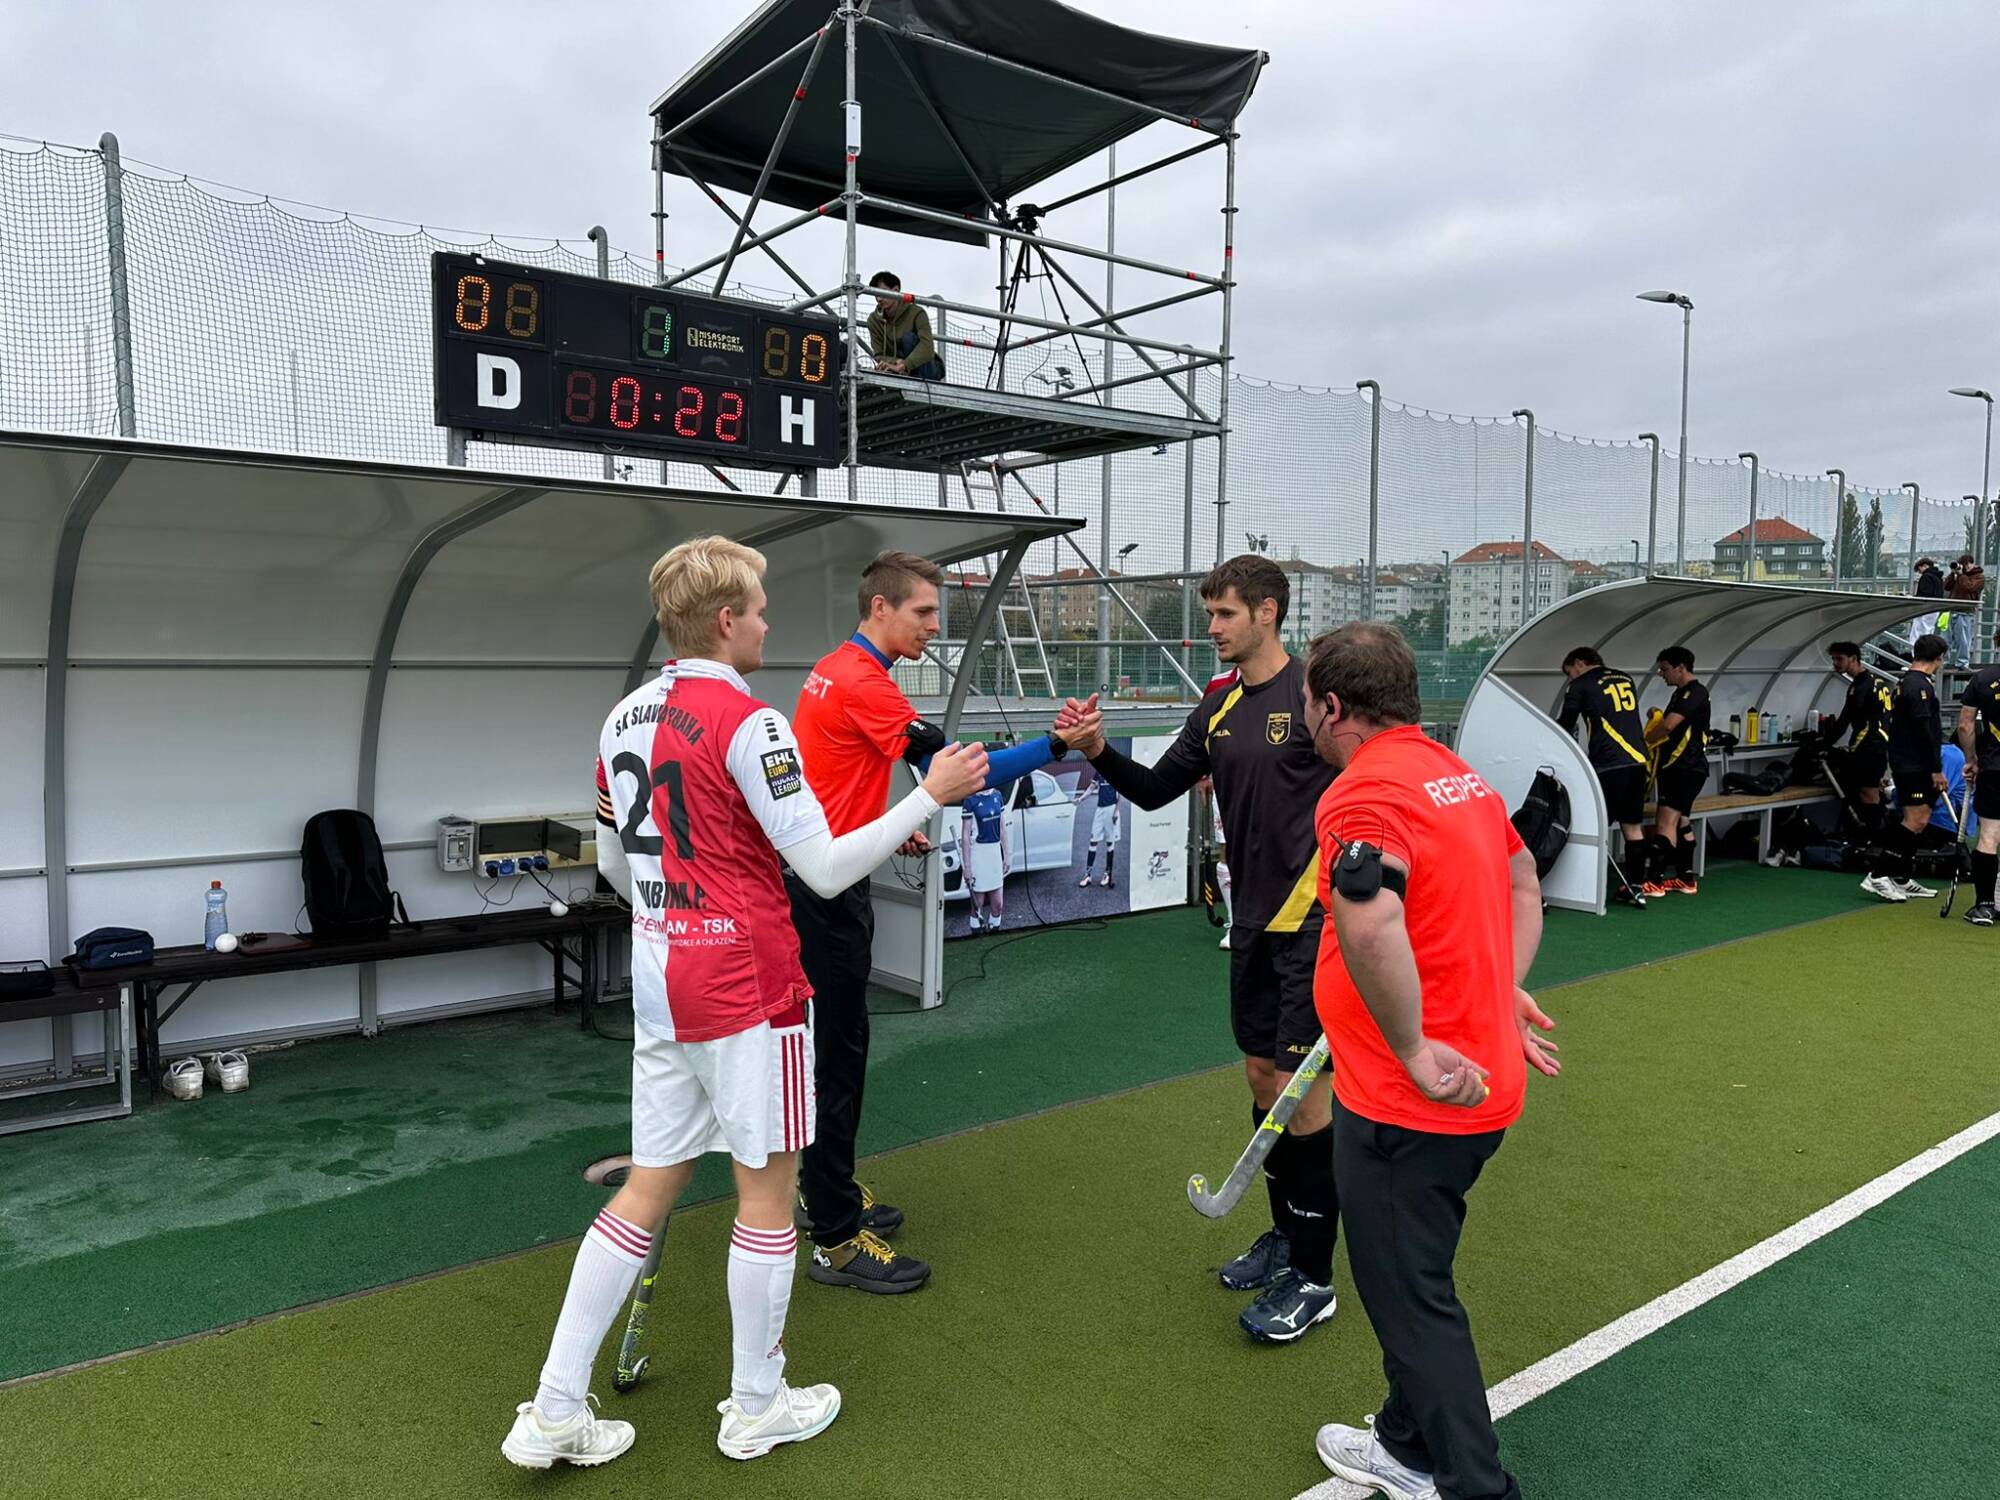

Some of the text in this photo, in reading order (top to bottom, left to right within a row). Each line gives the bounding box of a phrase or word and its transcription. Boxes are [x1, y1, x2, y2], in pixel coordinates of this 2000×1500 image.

[699, 339, 744, 353] ELEKTRONIK
[476, 352, 521, 410] D
[609, 375, 744, 443] 0:22
[780, 394, 815, 446] H
[1603, 682, 1636, 712] 15
[615, 711, 629, 737] SK
[764, 751, 794, 768] EHL
[768, 764, 789, 778] EURO
[611, 751, 695, 861] 21
[702, 918, 737, 934] TSK
[1286, 1044, 1313, 1054] ALE
